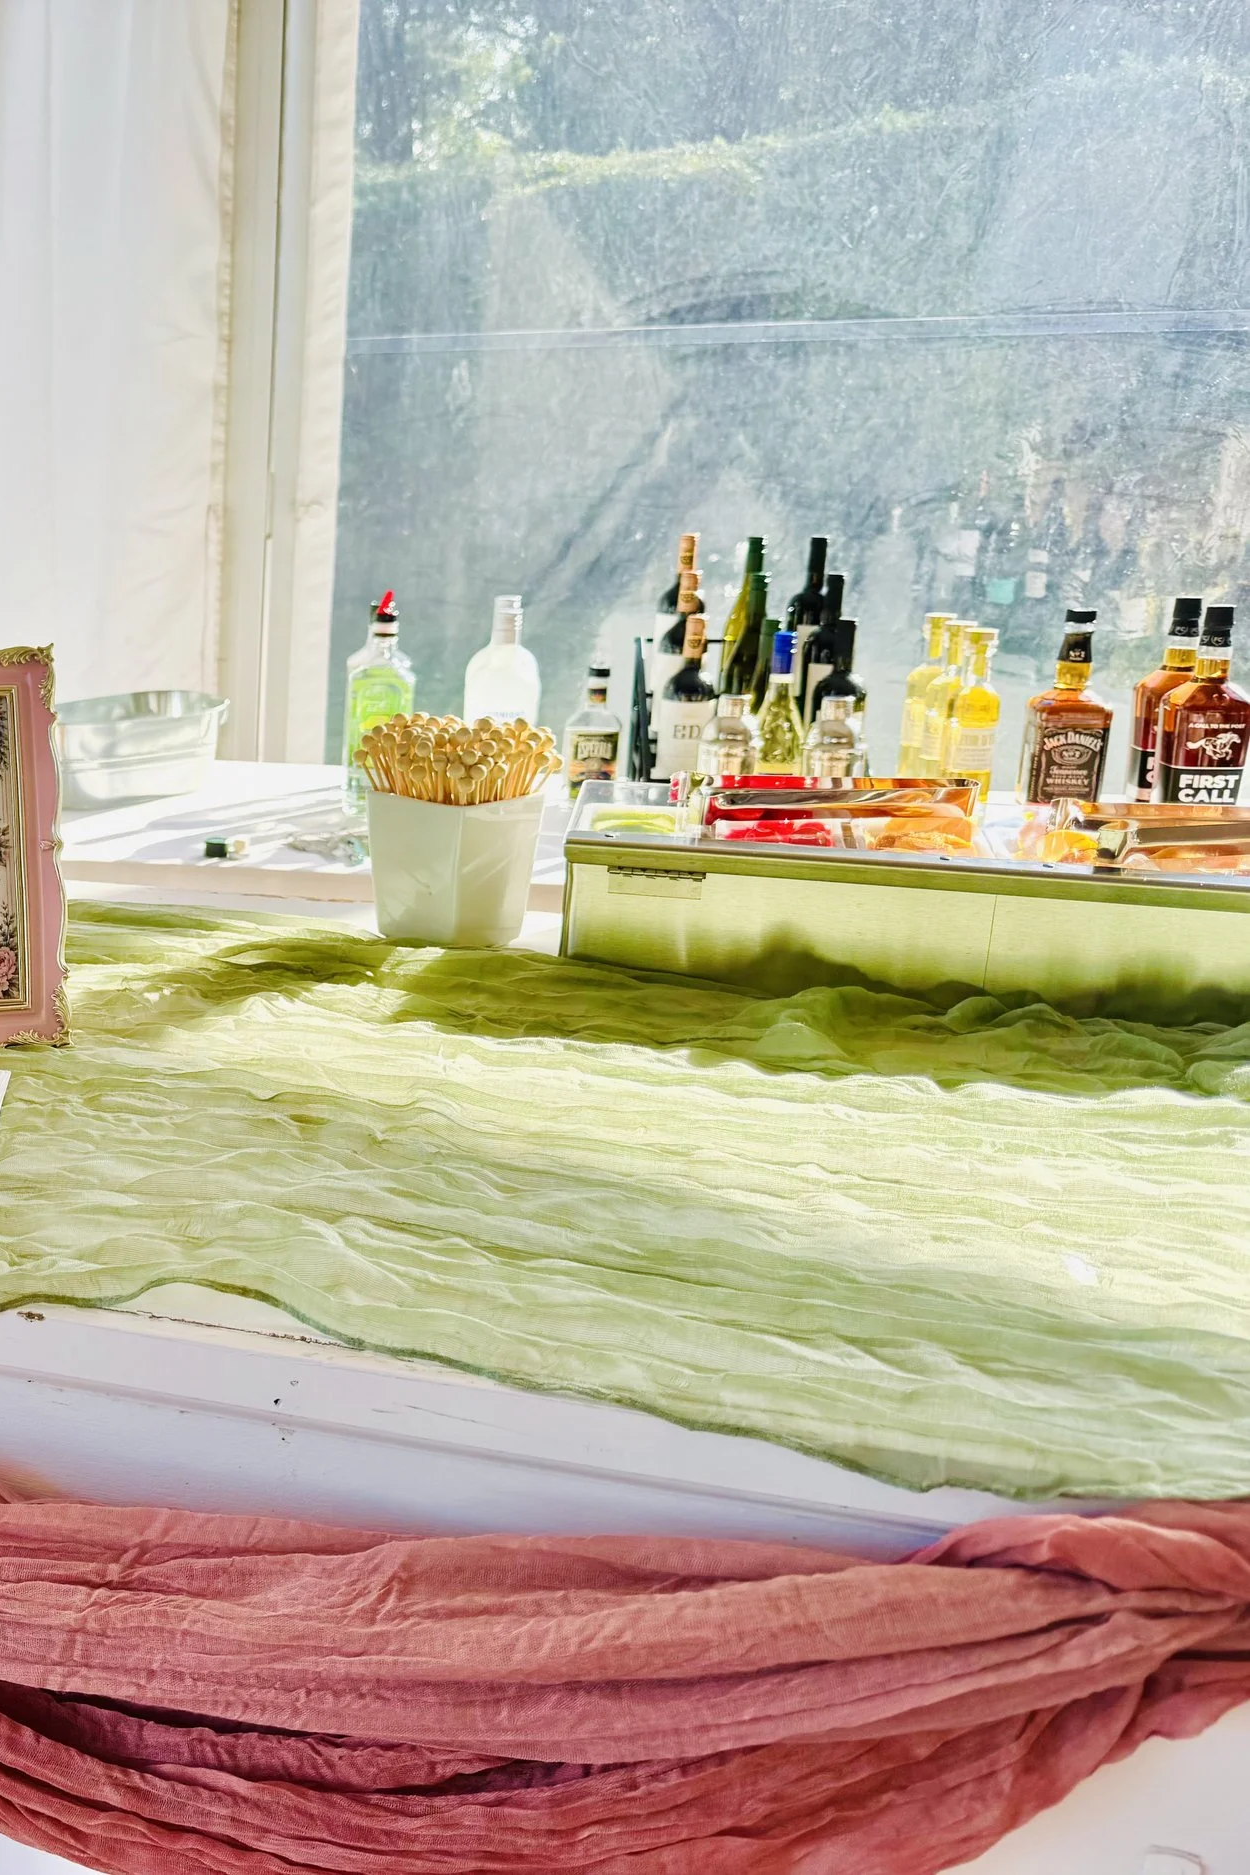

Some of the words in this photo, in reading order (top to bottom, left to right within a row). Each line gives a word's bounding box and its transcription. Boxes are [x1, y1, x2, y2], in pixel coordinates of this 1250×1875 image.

[1043, 734, 1067, 751] JACK
[1179, 774, 1239, 789] FIRST
[1178, 788, 1235, 803] CALL
